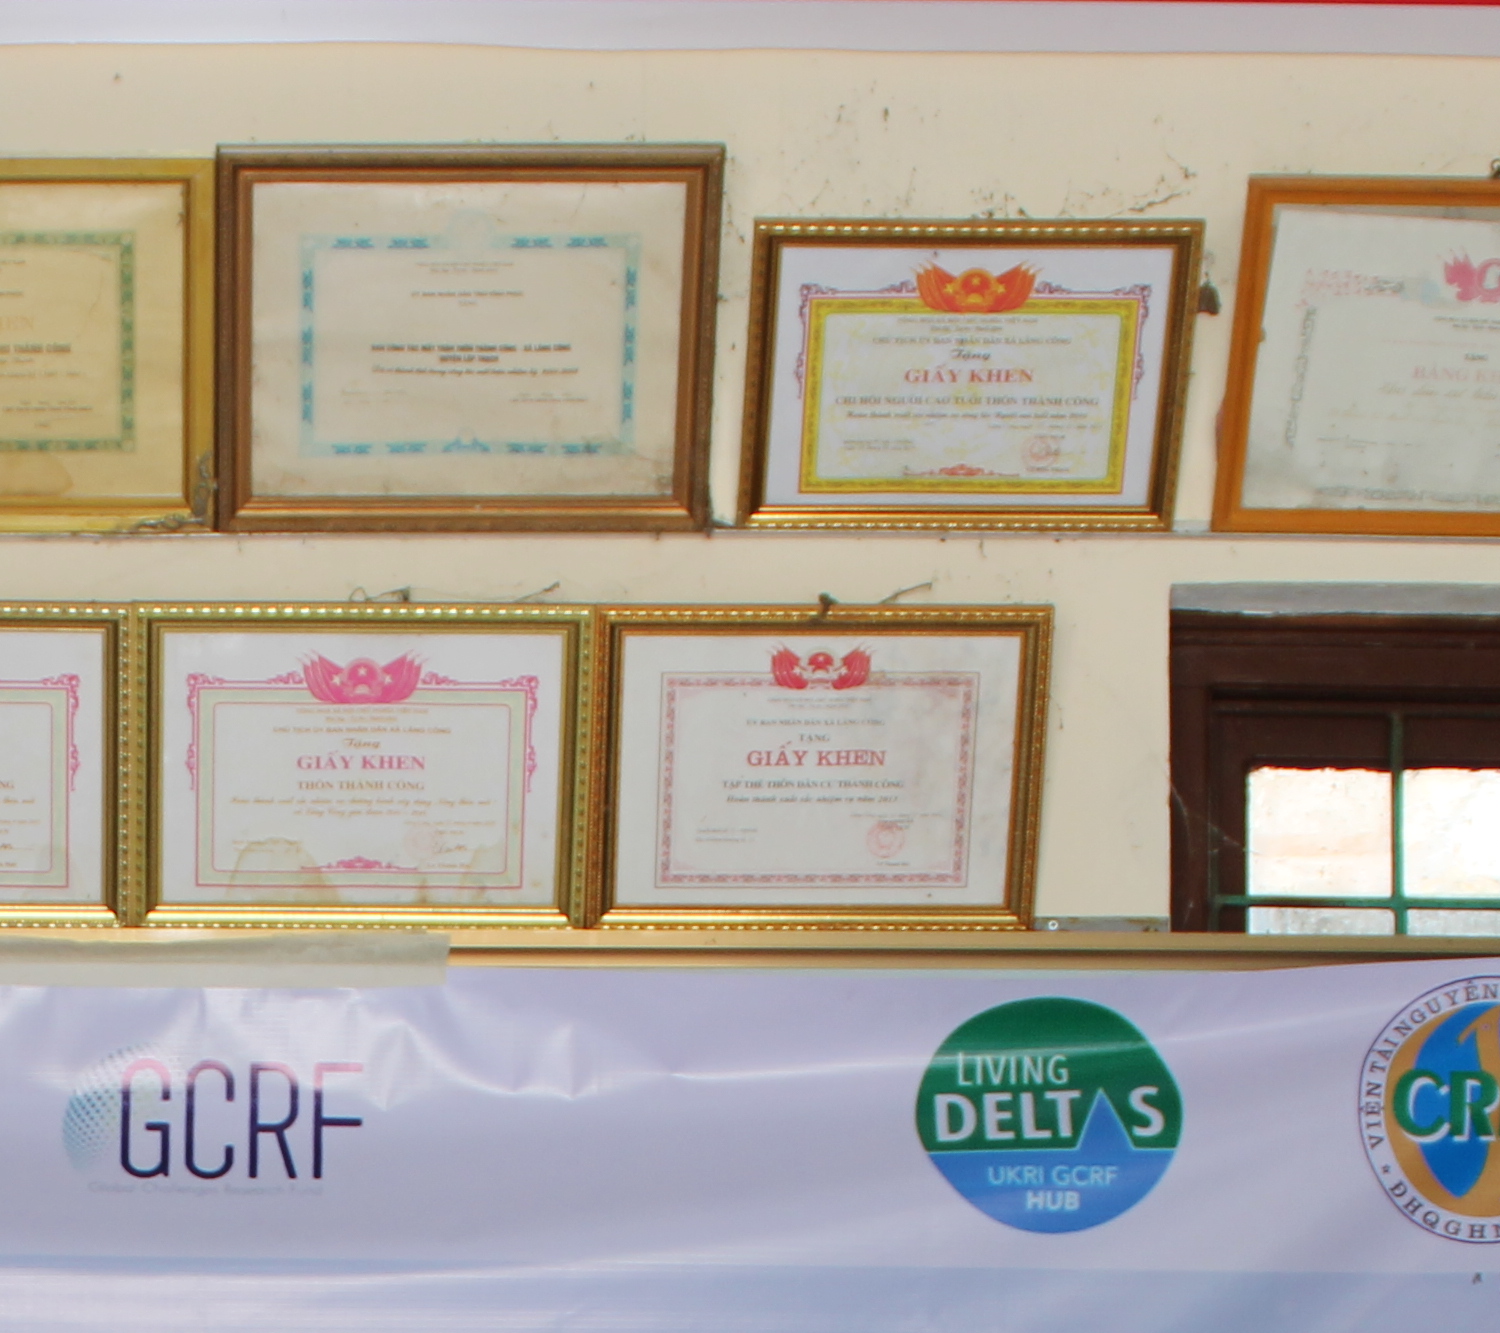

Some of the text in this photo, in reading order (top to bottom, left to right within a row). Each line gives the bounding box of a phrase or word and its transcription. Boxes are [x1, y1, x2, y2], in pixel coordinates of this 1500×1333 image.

[905, 364, 1034, 383] GIẤY KHEN
[297, 749, 426, 770] GIẤY KHEN
[747, 741, 887, 767] GIẤY KHEN
[956, 1051, 1071, 1086] LIVING
[1361, 1080, 1386, 1150] VIỆN
[1392, 980, 1500, 1041] NGUYÊN
[119, 1057, 365, 1179] GCRF
[933, 1085, 1167, 1148] DELTAS
[988, 1165, 1119, 1186] UKRI GCRF
[1025, 1190, 1082, 1212] HUB
